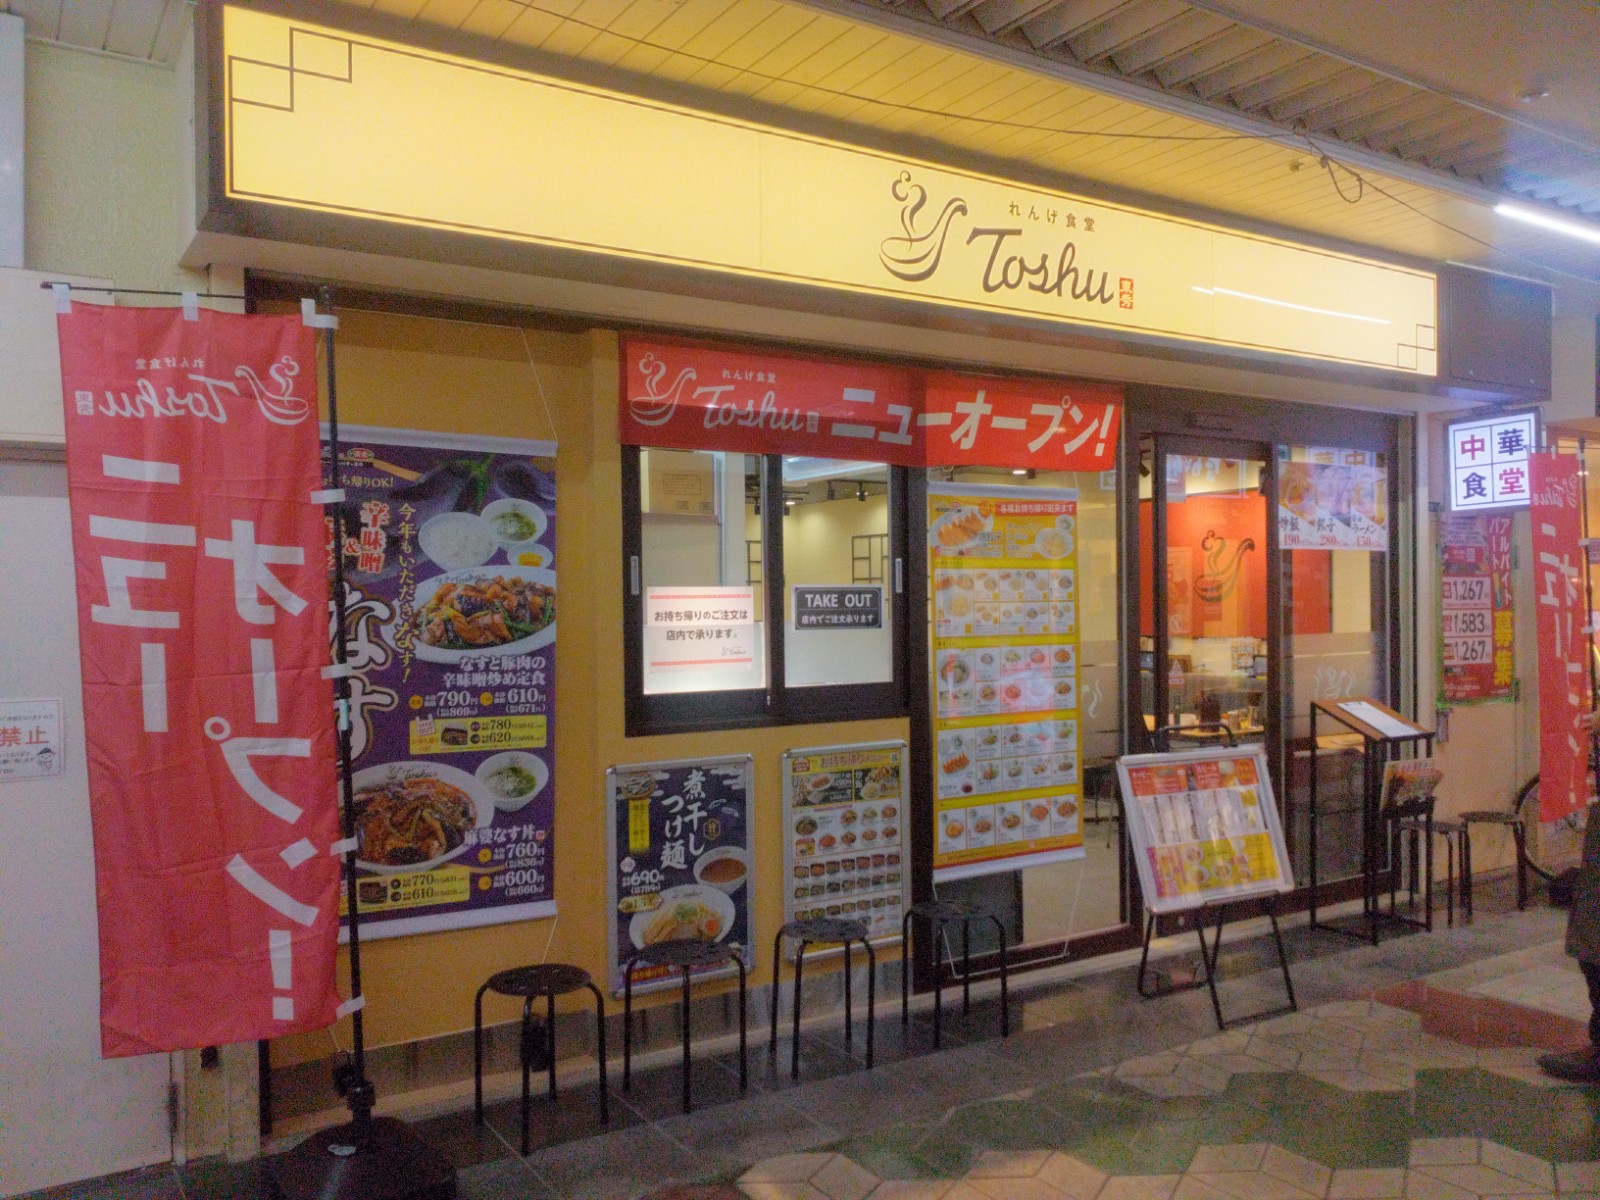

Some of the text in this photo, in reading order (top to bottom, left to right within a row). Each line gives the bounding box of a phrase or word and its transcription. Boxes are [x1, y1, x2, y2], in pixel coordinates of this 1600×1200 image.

[1009, 201, 1095, 232] れんげ食堂
[966, 227, 1114, 304] Toshu
[1119, 277, 1134, 310] 東秀
[721, 368, 776, 383] れんげ食堂
[692, 384, 804, 432] Toshu
[830, 387, 1116, 457] ニューオープン!
[1460, 427, 1526, 461] 中華
[1461, 466, 1527, 500] 食堂
[654, 609, 749, 623] お持ち帰りのご注文は
[804, 593, 873, 608] TAKE OUT
[666, 628, 739, 641] 店内で承ります。
[801, 614, 874, 626] 店内でご注文承ります
[1454, 612, 1486, 634] 1,583
[459, 655, 546, 671] なすと豚肉の
[683, 769, 708, 856] 煮干し
[661, 795, 688, 870] つけ麺
[631, 868, 665, 887] 690
